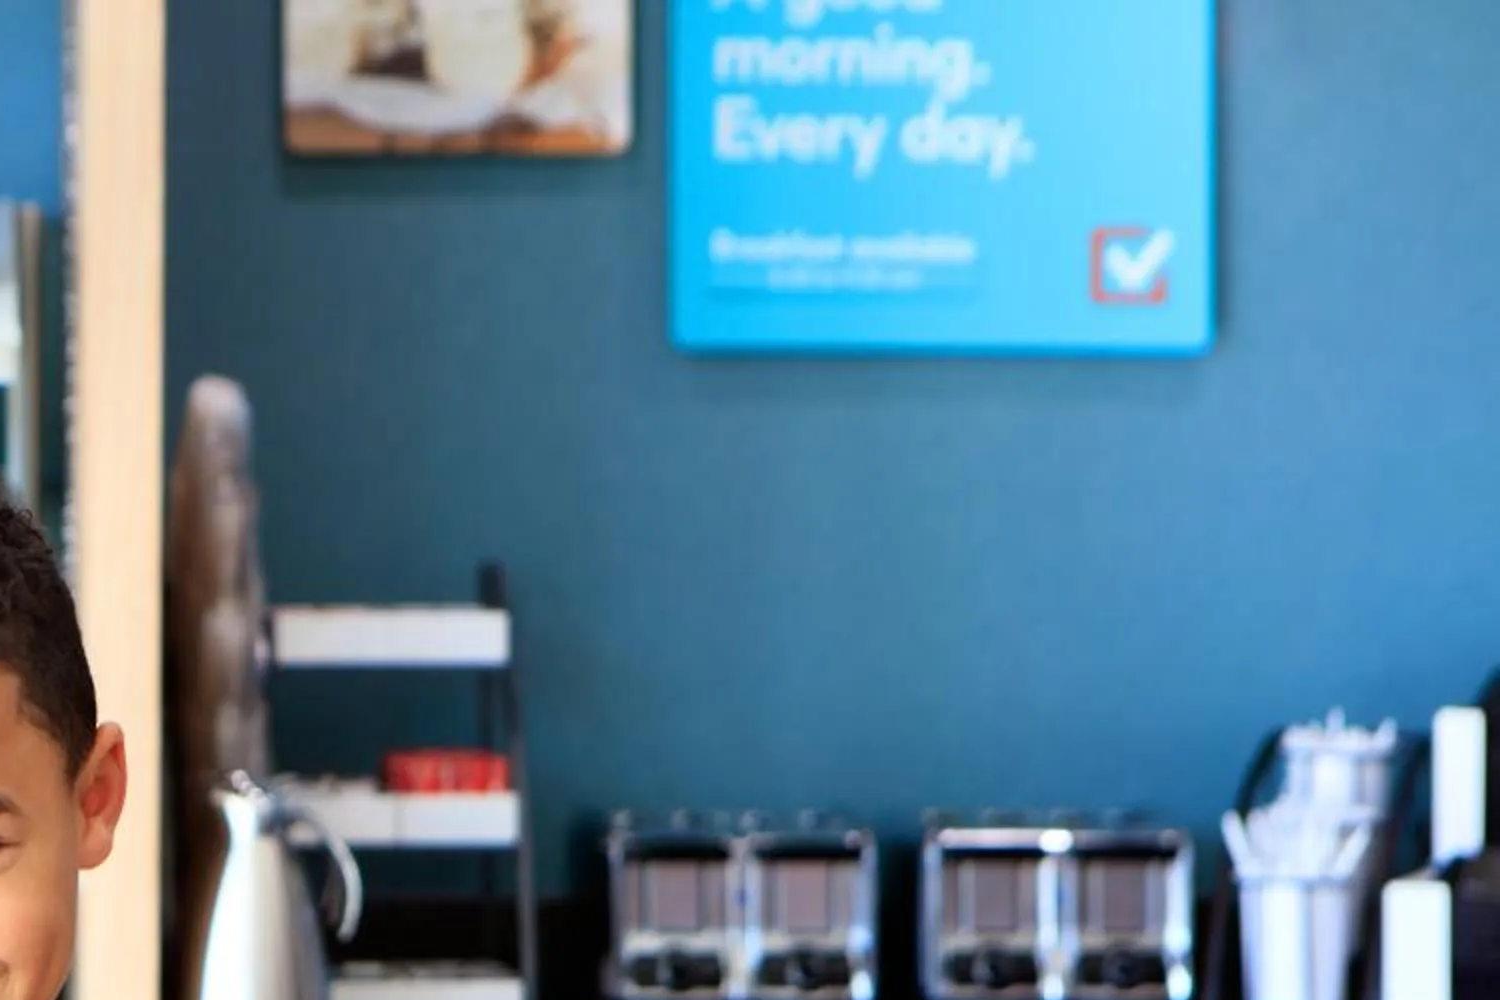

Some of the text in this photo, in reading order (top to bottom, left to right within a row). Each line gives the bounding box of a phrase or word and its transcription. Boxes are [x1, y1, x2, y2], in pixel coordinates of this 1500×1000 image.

[712, 21, 991, 101] morning.
[712, 93, 1036, 179] Every day.
